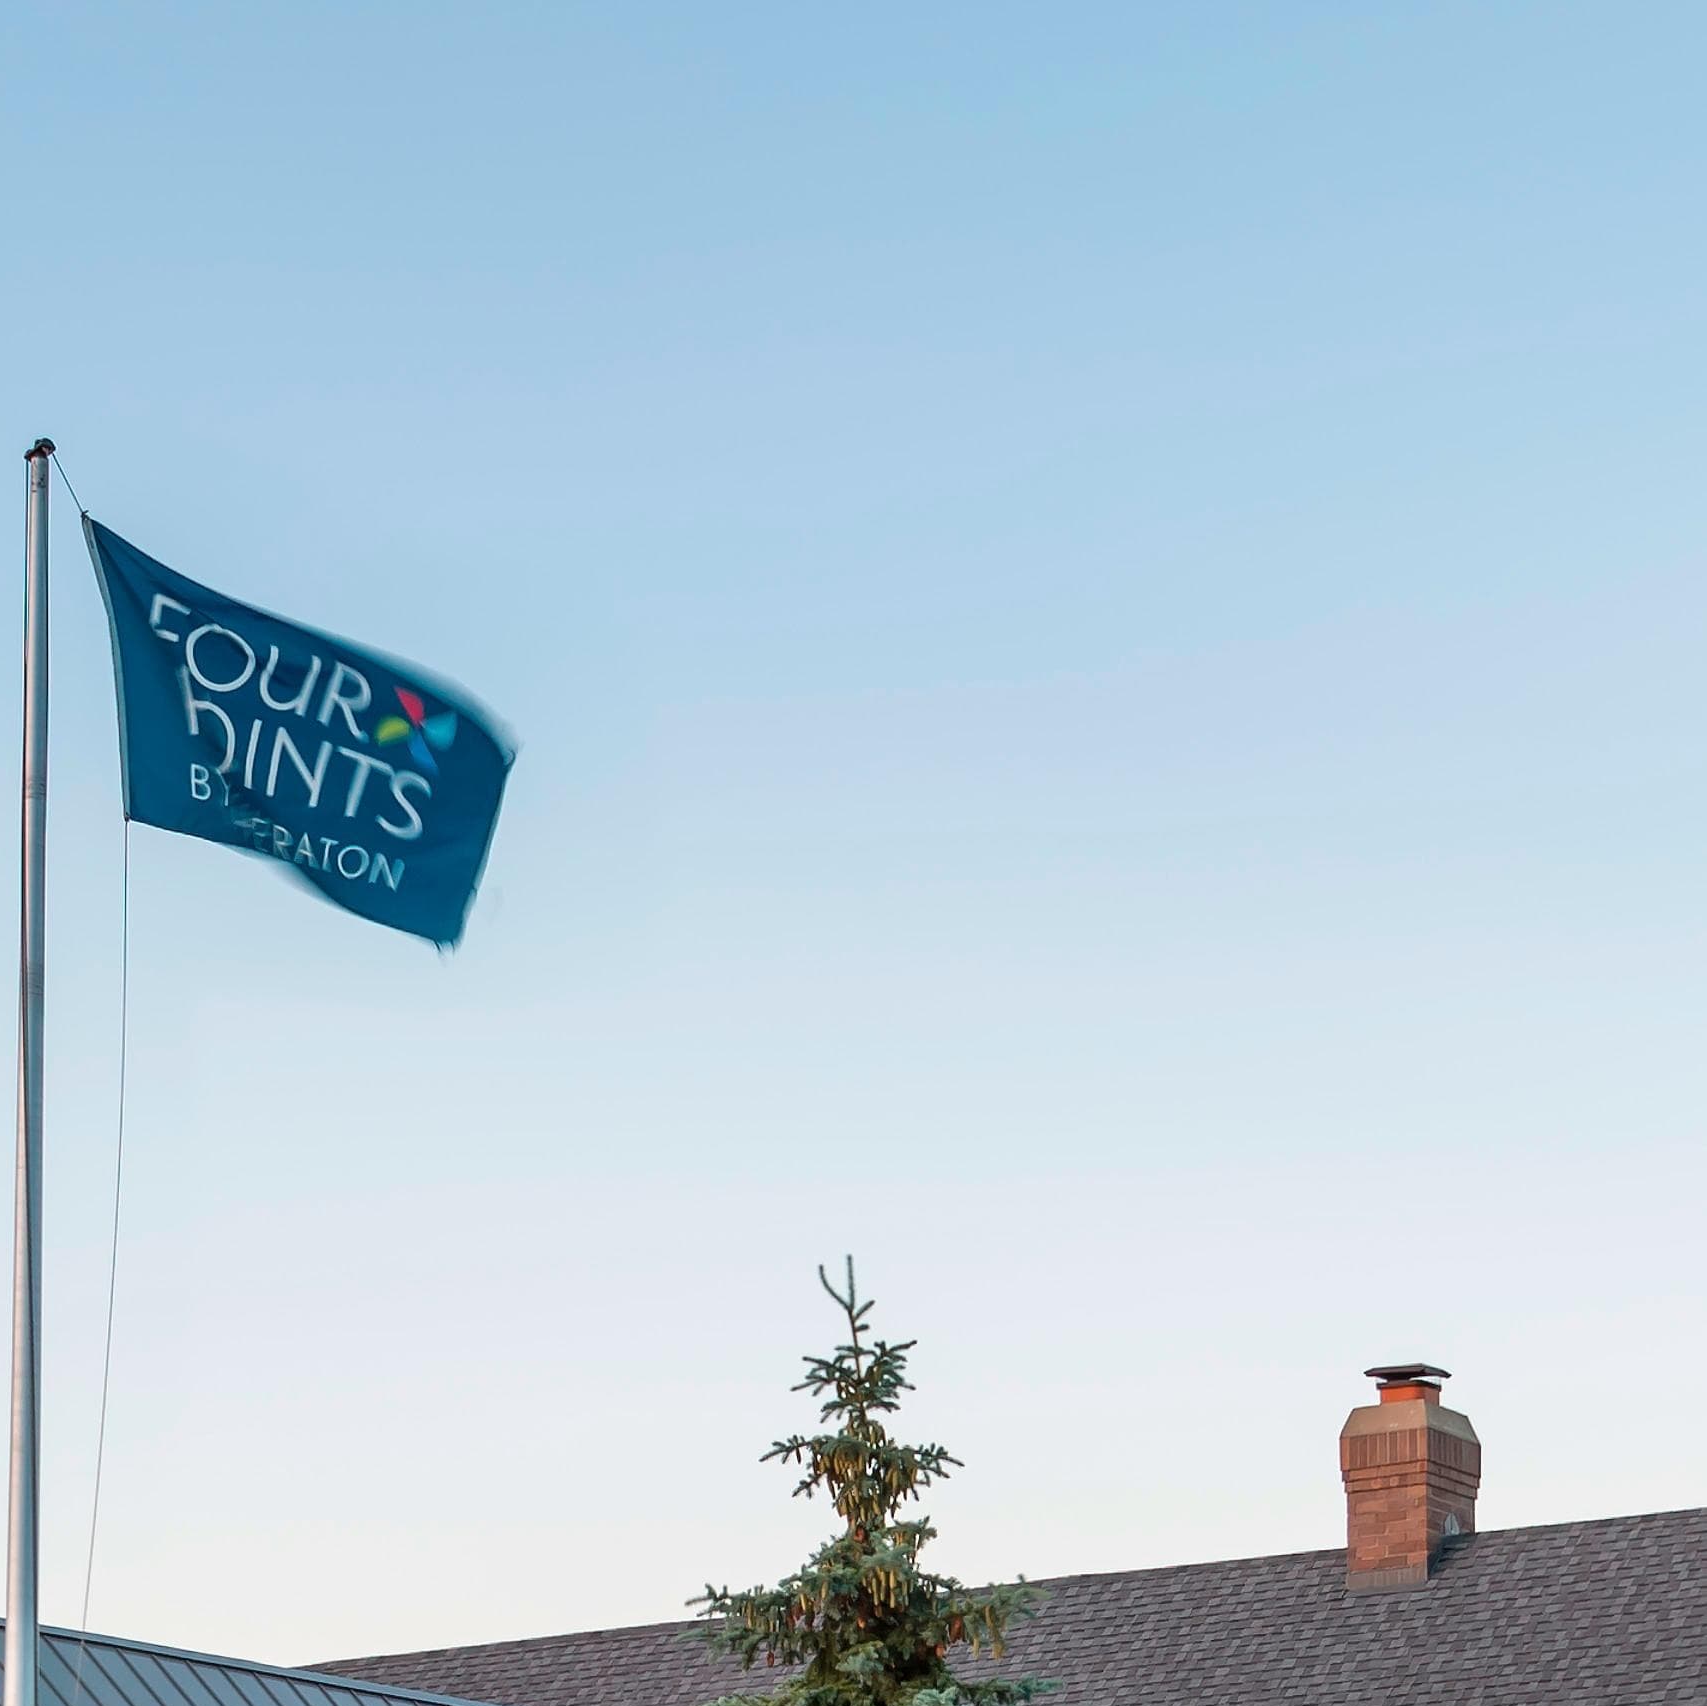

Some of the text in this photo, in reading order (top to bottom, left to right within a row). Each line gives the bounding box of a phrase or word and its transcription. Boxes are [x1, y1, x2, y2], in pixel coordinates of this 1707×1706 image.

[149, 593, 369, 744] FOUR
[190, 763, 406, 892] BY ERATON
